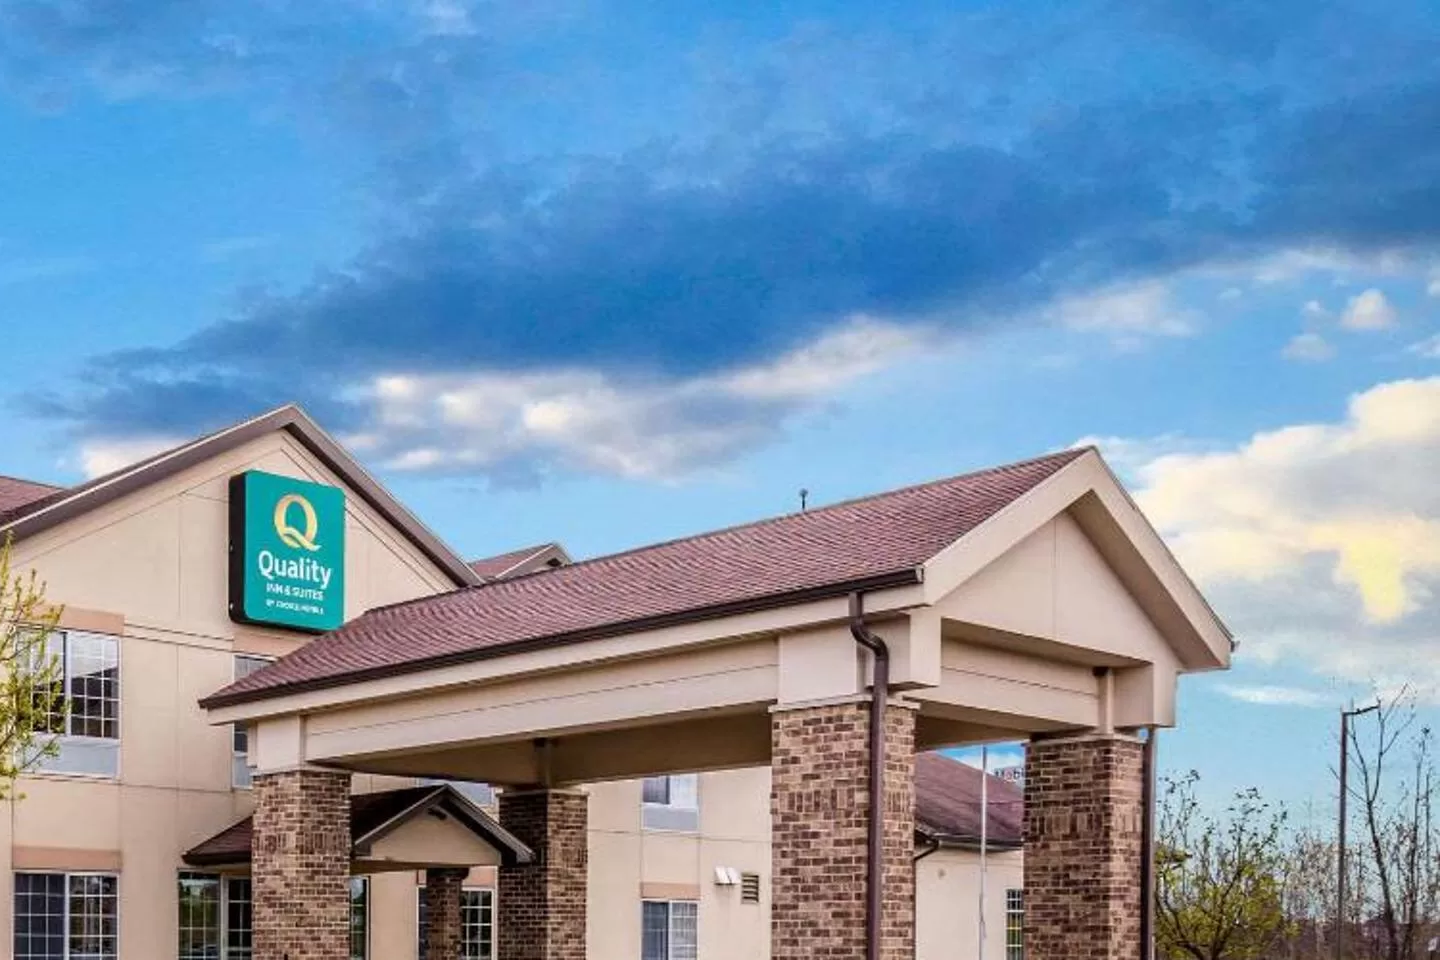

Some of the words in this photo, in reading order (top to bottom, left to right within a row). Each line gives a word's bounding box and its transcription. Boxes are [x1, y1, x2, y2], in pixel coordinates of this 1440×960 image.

[274, 493, 321, 551] Q
[258, 550, 332, 589] Quality
[266, 581, 283, 595] INN
[284, 585, 291, 596] &
[292, 586, 323, 601] SUITES
